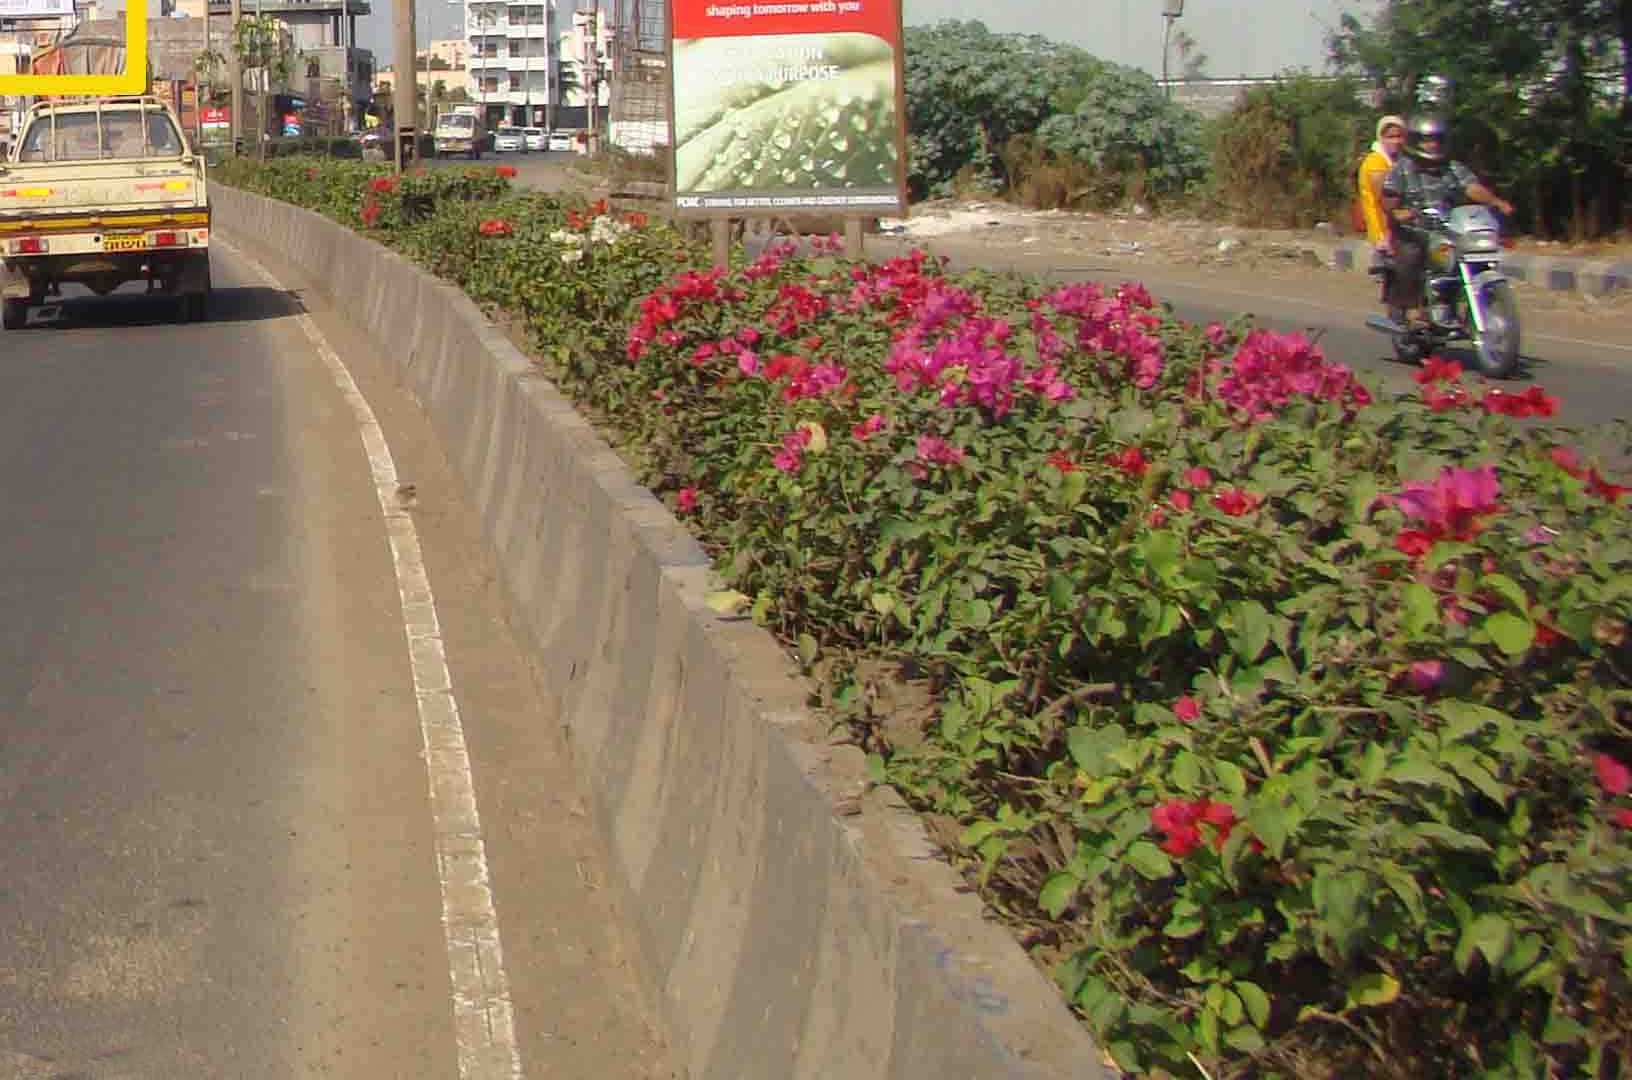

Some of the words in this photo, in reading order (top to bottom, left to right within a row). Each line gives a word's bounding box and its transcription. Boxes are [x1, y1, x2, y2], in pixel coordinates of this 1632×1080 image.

[704, 3, 752, 19] shaping
[753, 2, 809, 16] tomorrow
[811, 0, 836, 13] with
[837, 0, 861, 15] you
